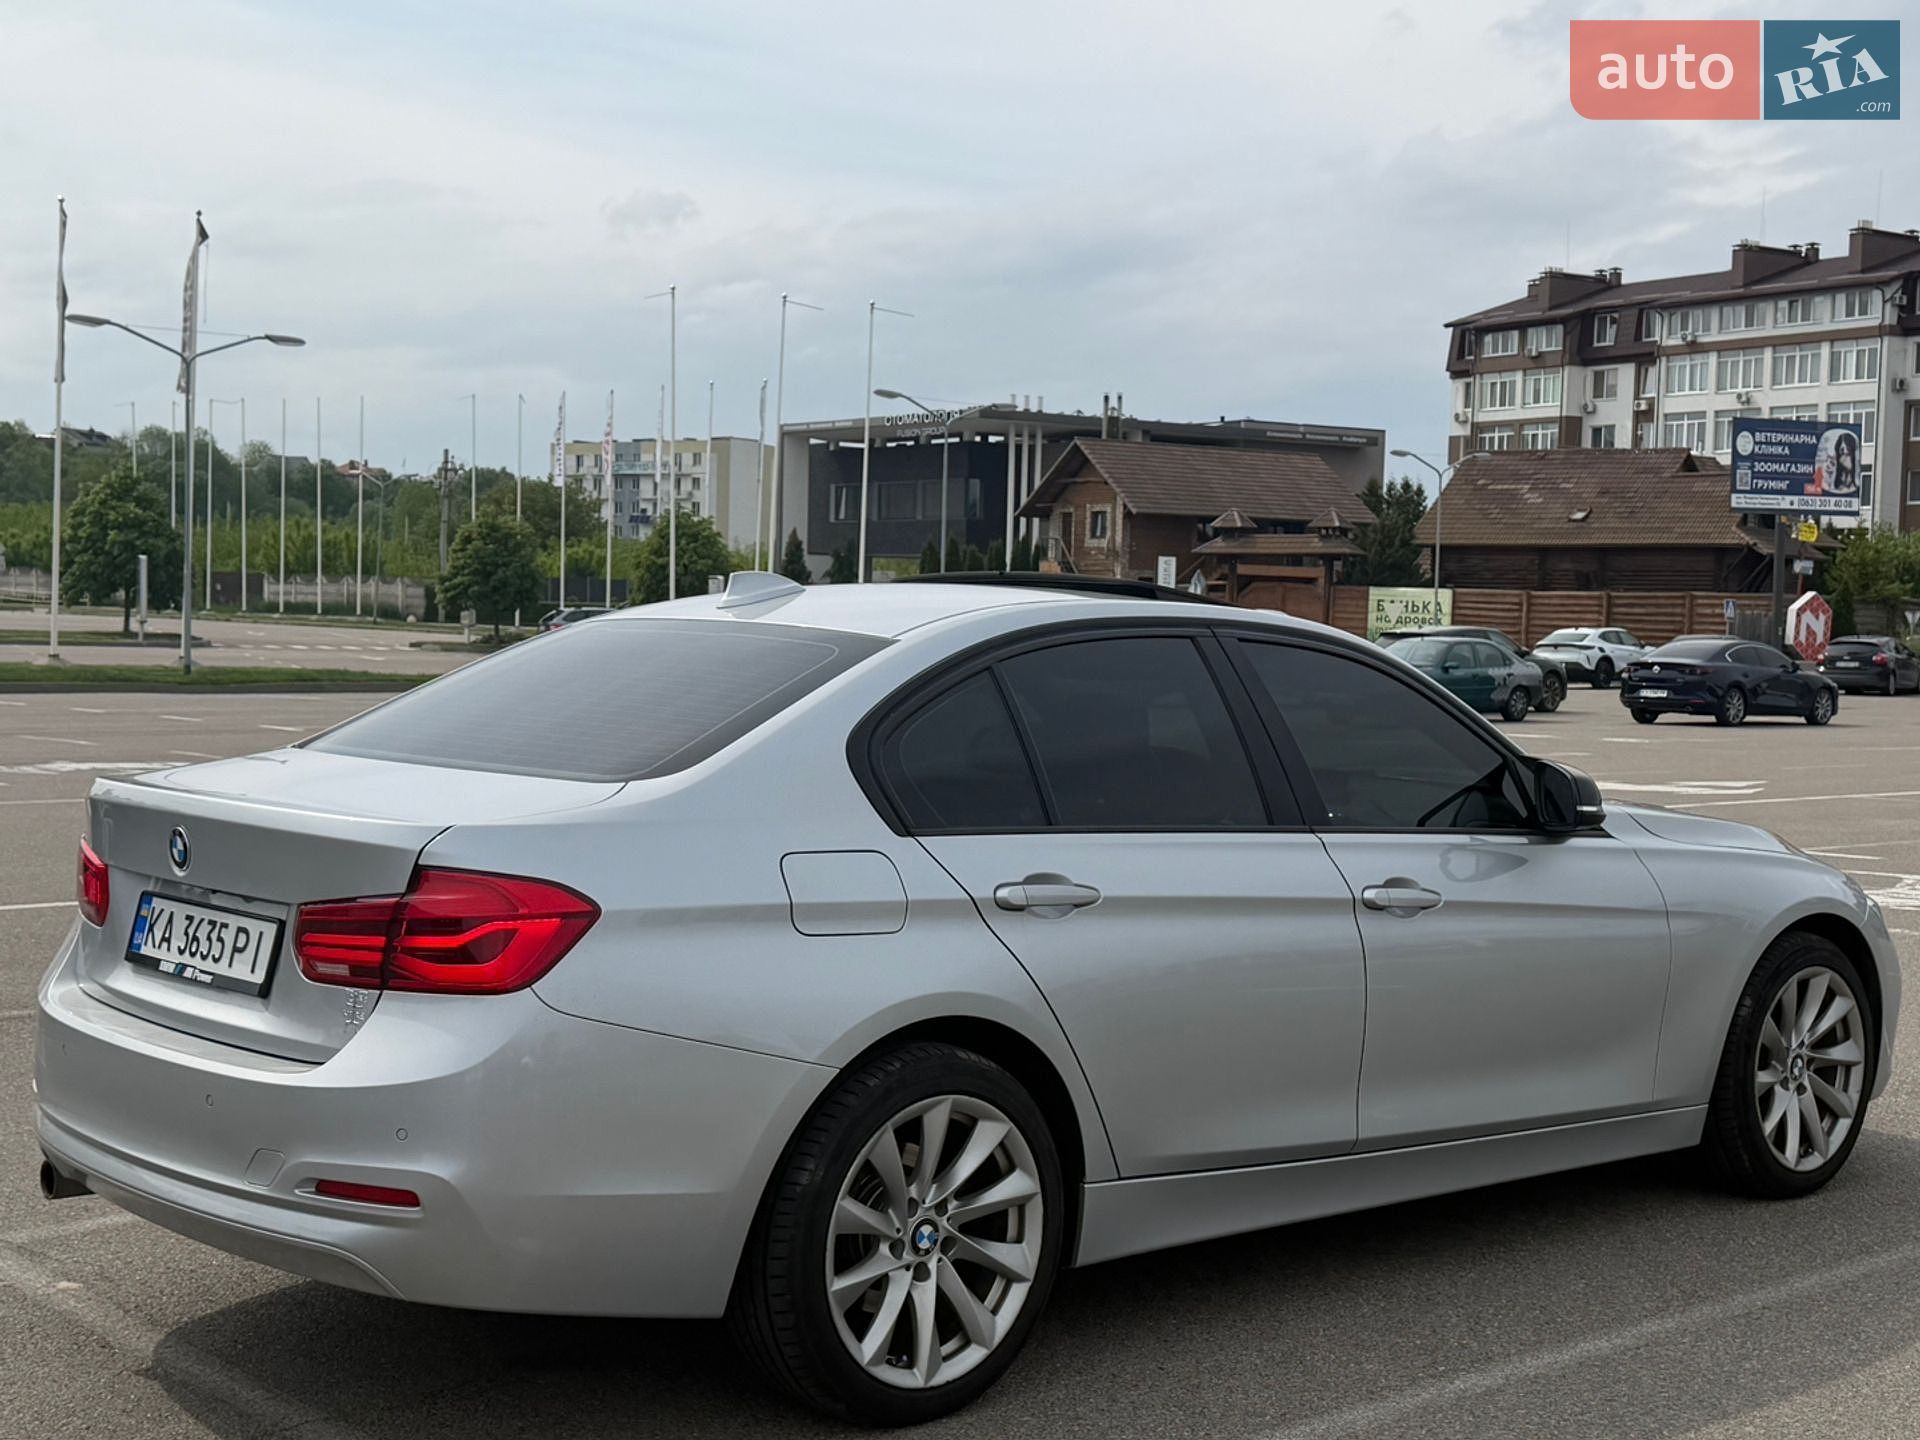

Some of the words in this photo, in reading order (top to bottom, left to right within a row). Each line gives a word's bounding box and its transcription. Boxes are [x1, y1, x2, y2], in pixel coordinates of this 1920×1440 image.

[1754, 432, 1817, 445] ВЕТЕРИНАРНА
[1754, 445, 1790, 456] КЛІНІКА
[1753, 462, 1814, 474] ЗООМАГАЗИН
[1752, 479, 1790, 490] ГРУМІНГ
[1376, 599, 1443, 614] БНЬКА
[143, 905, 175, 953] KA
[177, 914, 230, 965] 3635
[228, 925, 264, 975] PI
